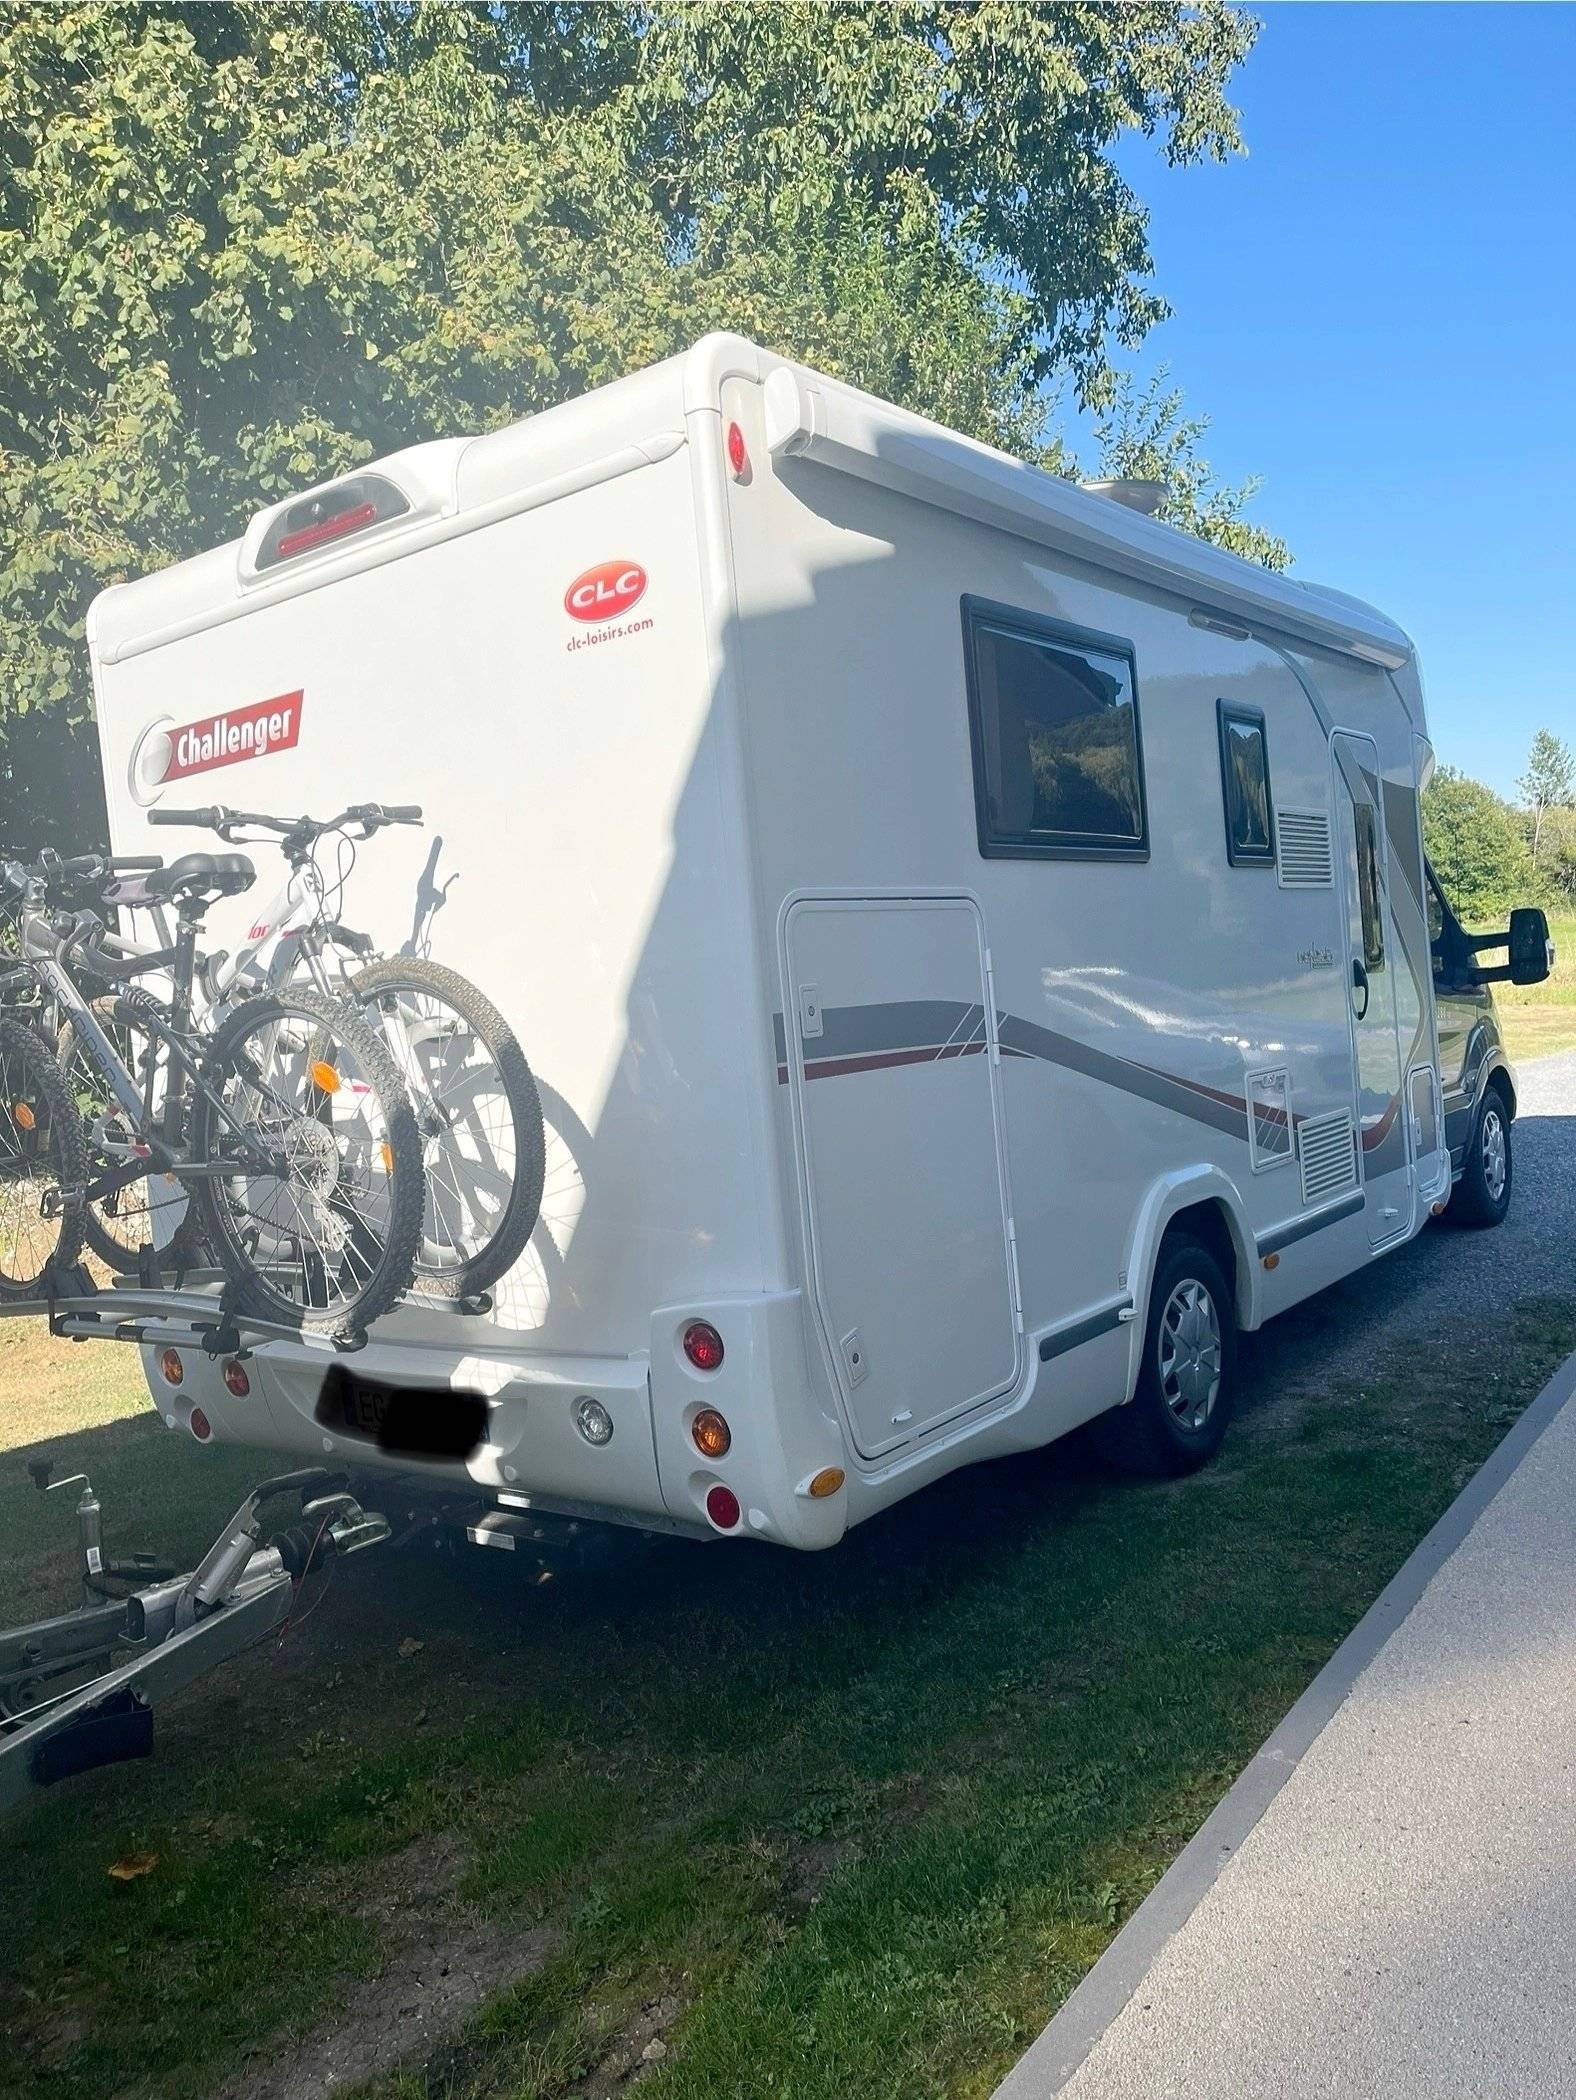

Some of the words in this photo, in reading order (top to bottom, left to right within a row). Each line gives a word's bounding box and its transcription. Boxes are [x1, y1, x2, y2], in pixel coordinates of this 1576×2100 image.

[572, 570, 640, 608] CLC
[567, 618, 654, 652] clc-loisirs.com
[177, 708, 293, 768] Challenger
